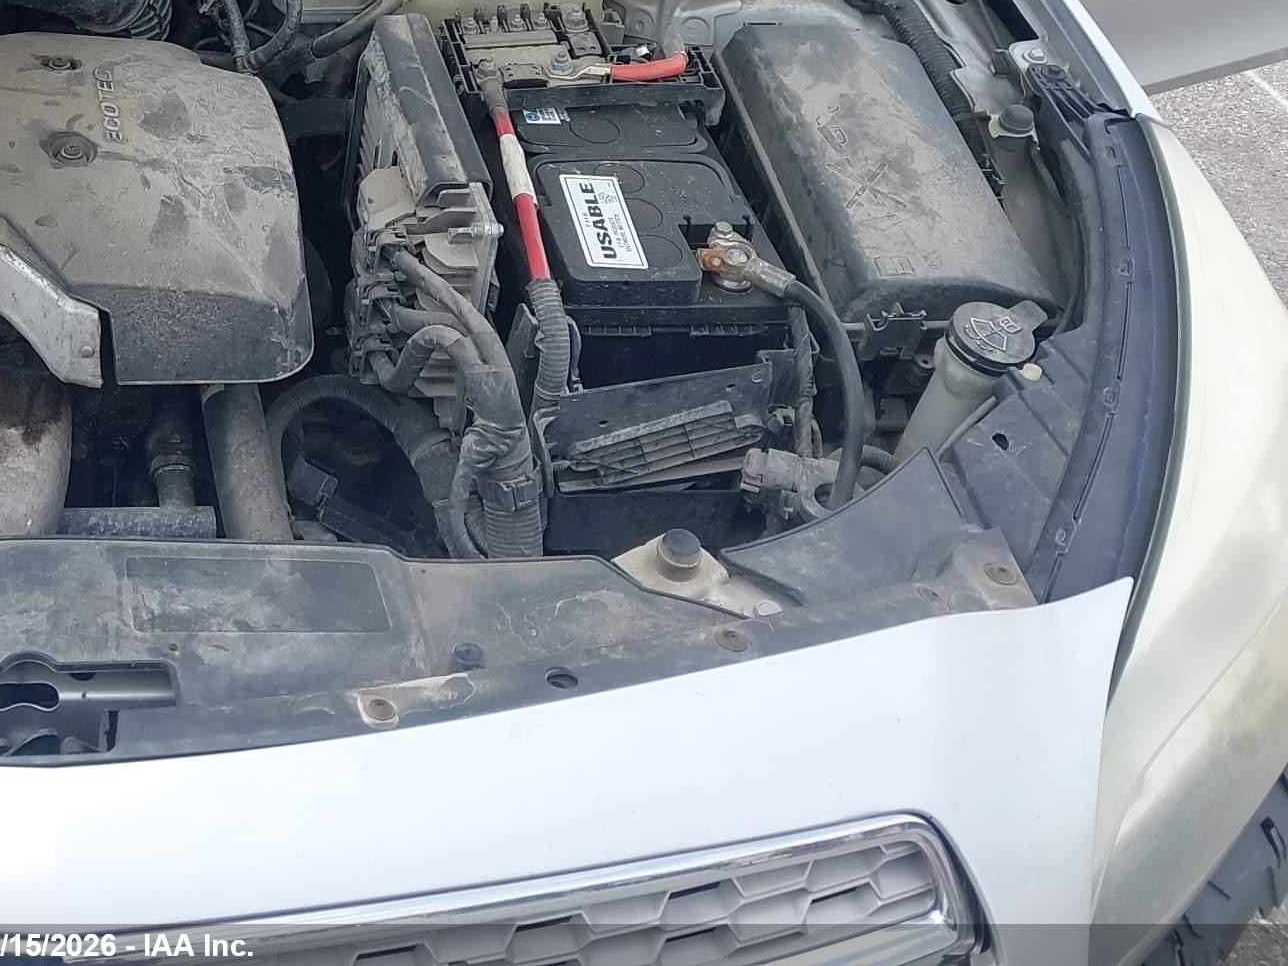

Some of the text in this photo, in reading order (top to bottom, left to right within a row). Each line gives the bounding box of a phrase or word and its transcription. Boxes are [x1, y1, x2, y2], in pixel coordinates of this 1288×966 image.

[94, 68, 123, 142] ECOTEC
[579, 183, 617, 259] USABLE
[582, 211, 591, 227] THE
